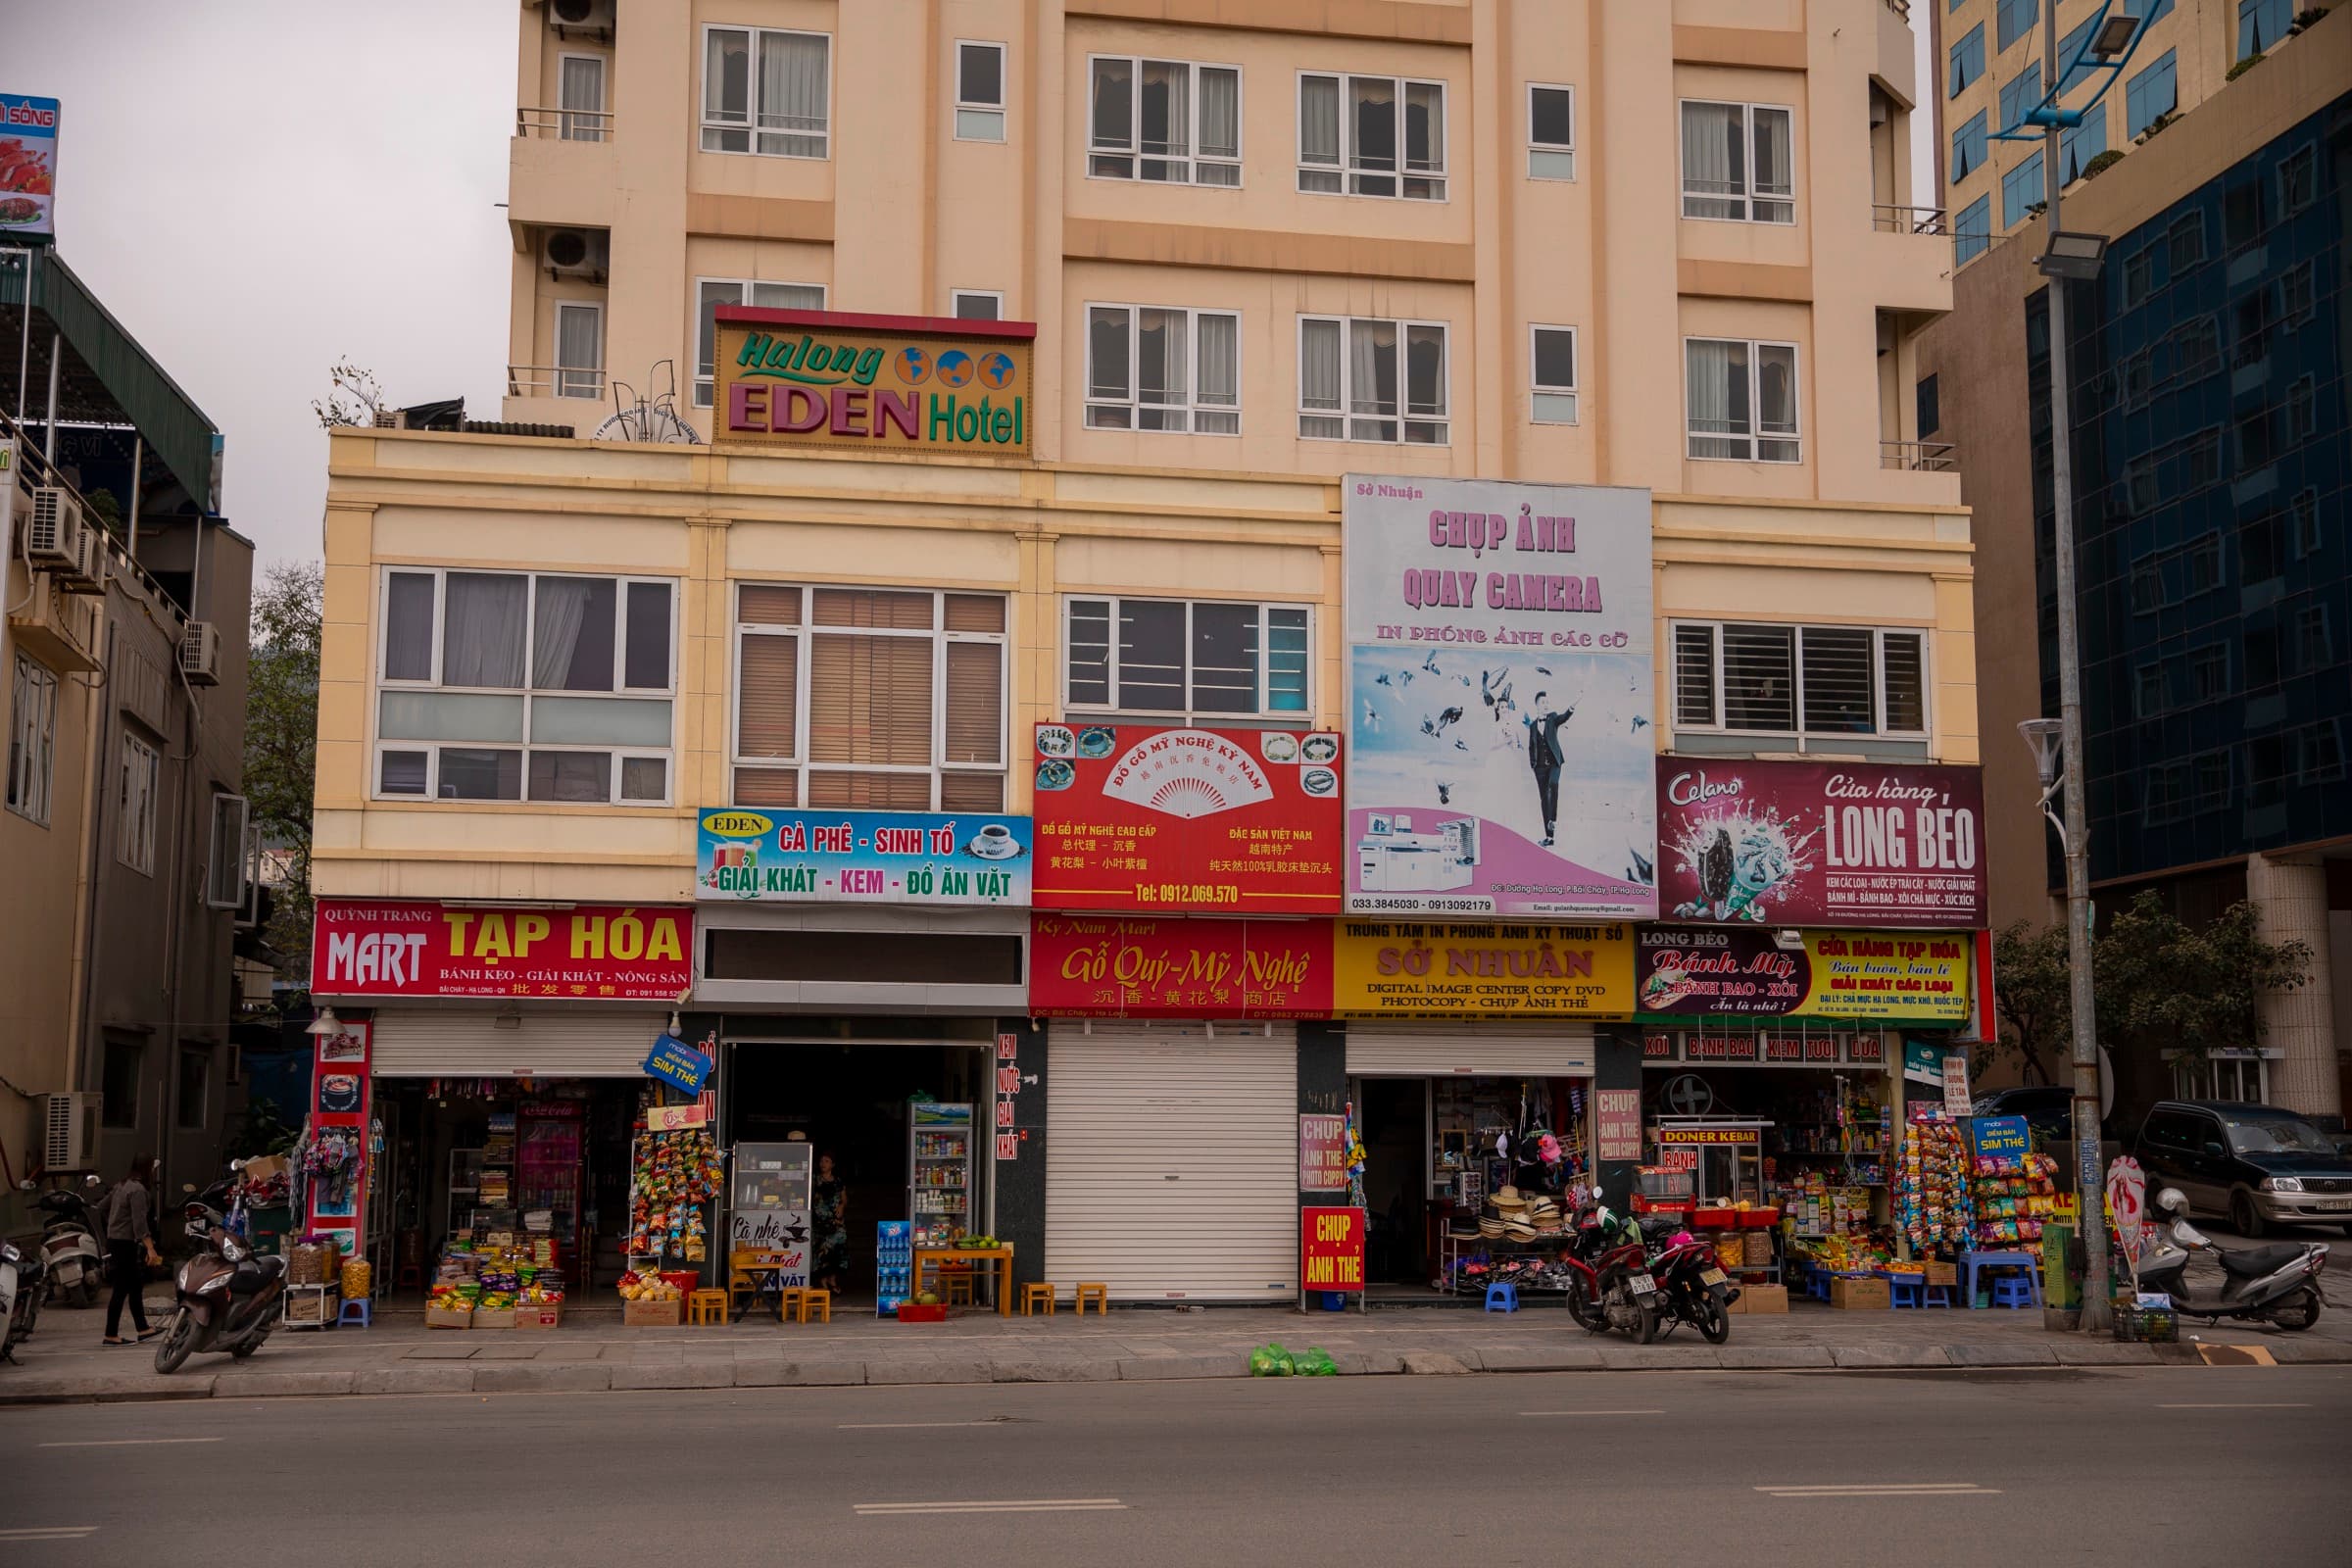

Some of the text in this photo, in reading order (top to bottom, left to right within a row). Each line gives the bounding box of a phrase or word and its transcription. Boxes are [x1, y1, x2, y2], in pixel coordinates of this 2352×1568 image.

[9, 100, 54, 126] SỐNG
[736, 331, 886, 386] Halong
[728, 381, 920, 440] EDEN
[929, 393, 1023, 445] Hotel
[1378, 484, 1424, 502] Nhuận
[1429, 502, 1576, 559] CHỤP ẢNH
[1402, 567, 1602, 613] QUAY CAMERA
[1377, 624, 1592, 647] IN PHÓNG ẢNH CÁC
[1175, 736, 1215, 751] NGHỆ
[1238, 760, 1263, 791] NAM
[1667, 770, 1741, 806] Celano
[1824, 773, 1937, 809] Cửa hàng
[712, 816, 763, 832] EDEN
[1117, 826, 1136, 836] CAO
[1825, 792, 1975, 870] LONG BÉO
[779, 821, 956, 856] CÀ PHÊ SINH TỐ
[1293, 830, 1312, 840] NAM
[1113, 840, 1136, 853] 沉香
[1249, 843, 1294, 856] 越南特产
[1051, 857, 1085, 869] 黄花梨
[718, 857, 1011, 902] GIẢI KHÁT KEM ĐỒ ĂN VẶT
[1827, 877, 1839, 888] KEM
[1840, 875, 1853, 888] CÁC
[1960, 879, 1976, 891] KHÁT
[1136, 884, 1238, 904] Tel: 0912.069.570
[1632, 887, 1650, 897] Long
[1827, 892, 1845, 903] BÁNH
[1860, 892, 1879, 904] BÁNH
[1880, 894, 1893, 904] BAO
[1352, 898, 1492, 911] 033.3845030 0913092179
[381, 910, 431, 922] TRANG
[443, 908, 683, 965] TẠP HÓA
[1066, 921, 1156, 937] Nam Mart
[1347, 924, 1444, 938] TRUNG IN
[1641, 930, 1729, 947] LONG BÉO
[327, 932, 427, 988] MART
[1897, 942, 1927, 960] TẠP
[1061, 941, 1310, 993] Gỗ Nghệ
[1652, 949, 1740, 977] Bánh
[1829, 960, 1933, 975] Bán bán
[440, 967, 687, 984] BÁNH KẸO GIẢI KHÁT NÔNG SẢN
[513, 983, 615, 996] 批发零售
[1093, 989, 1287, 1006] 沉香 黄花梨 商店
[1367, 983, 1606, 996] DIGITAL IMAGE CENTER COPY DVD
[1722, 980, 1798, 997] BAO XÔI
[1381, 997, 1467, 1007] PHOTOCOPY
[1480, 998, 1519, 1010] CHỤP
[1525, 995, 1556, 1008] ẢNH
[1737, 1002, 1750, 1010] là
[998, 1034, 1017, 1059] KEM
[1729, 1038, 1754, 1056] BAO
[1767, 1038, 1799, 1058] KEM
[652, 1056, 672, 1074] SIM
[998, 1060, 1020, 1094] NƯỚC
[998, 1094, 1014, 1127] GIẢI
[1598, 1094, 1638, 1117] CHỤP
[1302, 1120, 1344, 1144] CHỤP
[1665, 1132, 1717, 1142] DONER
[997, 1129, 1018, 1159] KHÁT
[1600, 1141, 1641, 1159] PHOTO COPPY
[1981, 1139, 2002, 1150] SIM
[1302, 1170, 1344, 1186] PHOTO COPPY
[733, 1216, 751, 1240] Cà
[1316, 1214, 1351, 1248] CHỤP
[1306, 1245, 1361, 1283] ẢNH THẺ
